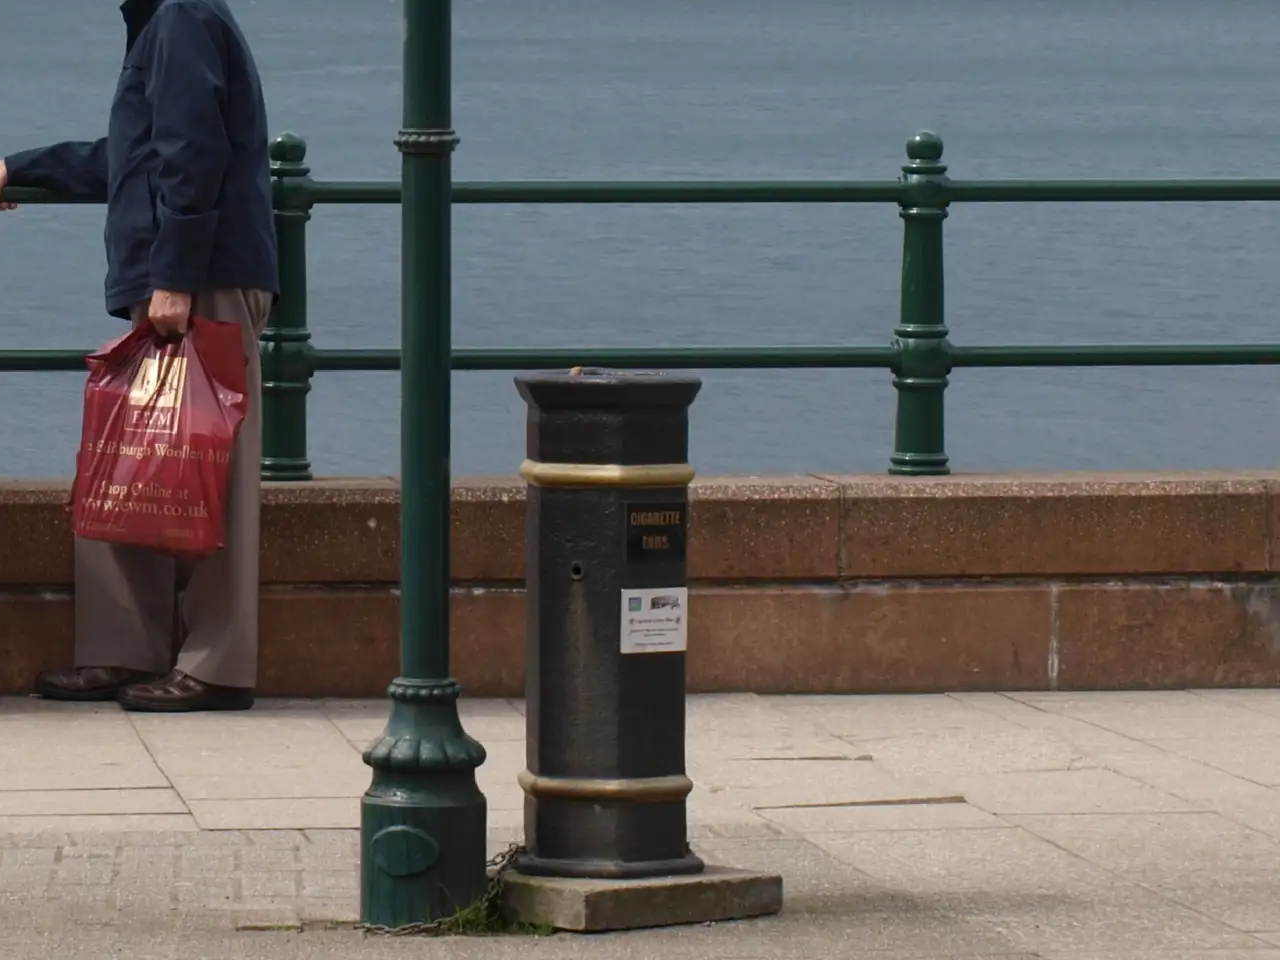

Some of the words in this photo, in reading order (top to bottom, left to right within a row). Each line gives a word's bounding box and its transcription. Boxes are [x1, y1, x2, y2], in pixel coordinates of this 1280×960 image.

[154, 443, 203, 461] Woollen
[131, 482, 172, 499] Online
[630, 511, 680, 526] CIGARETTE
